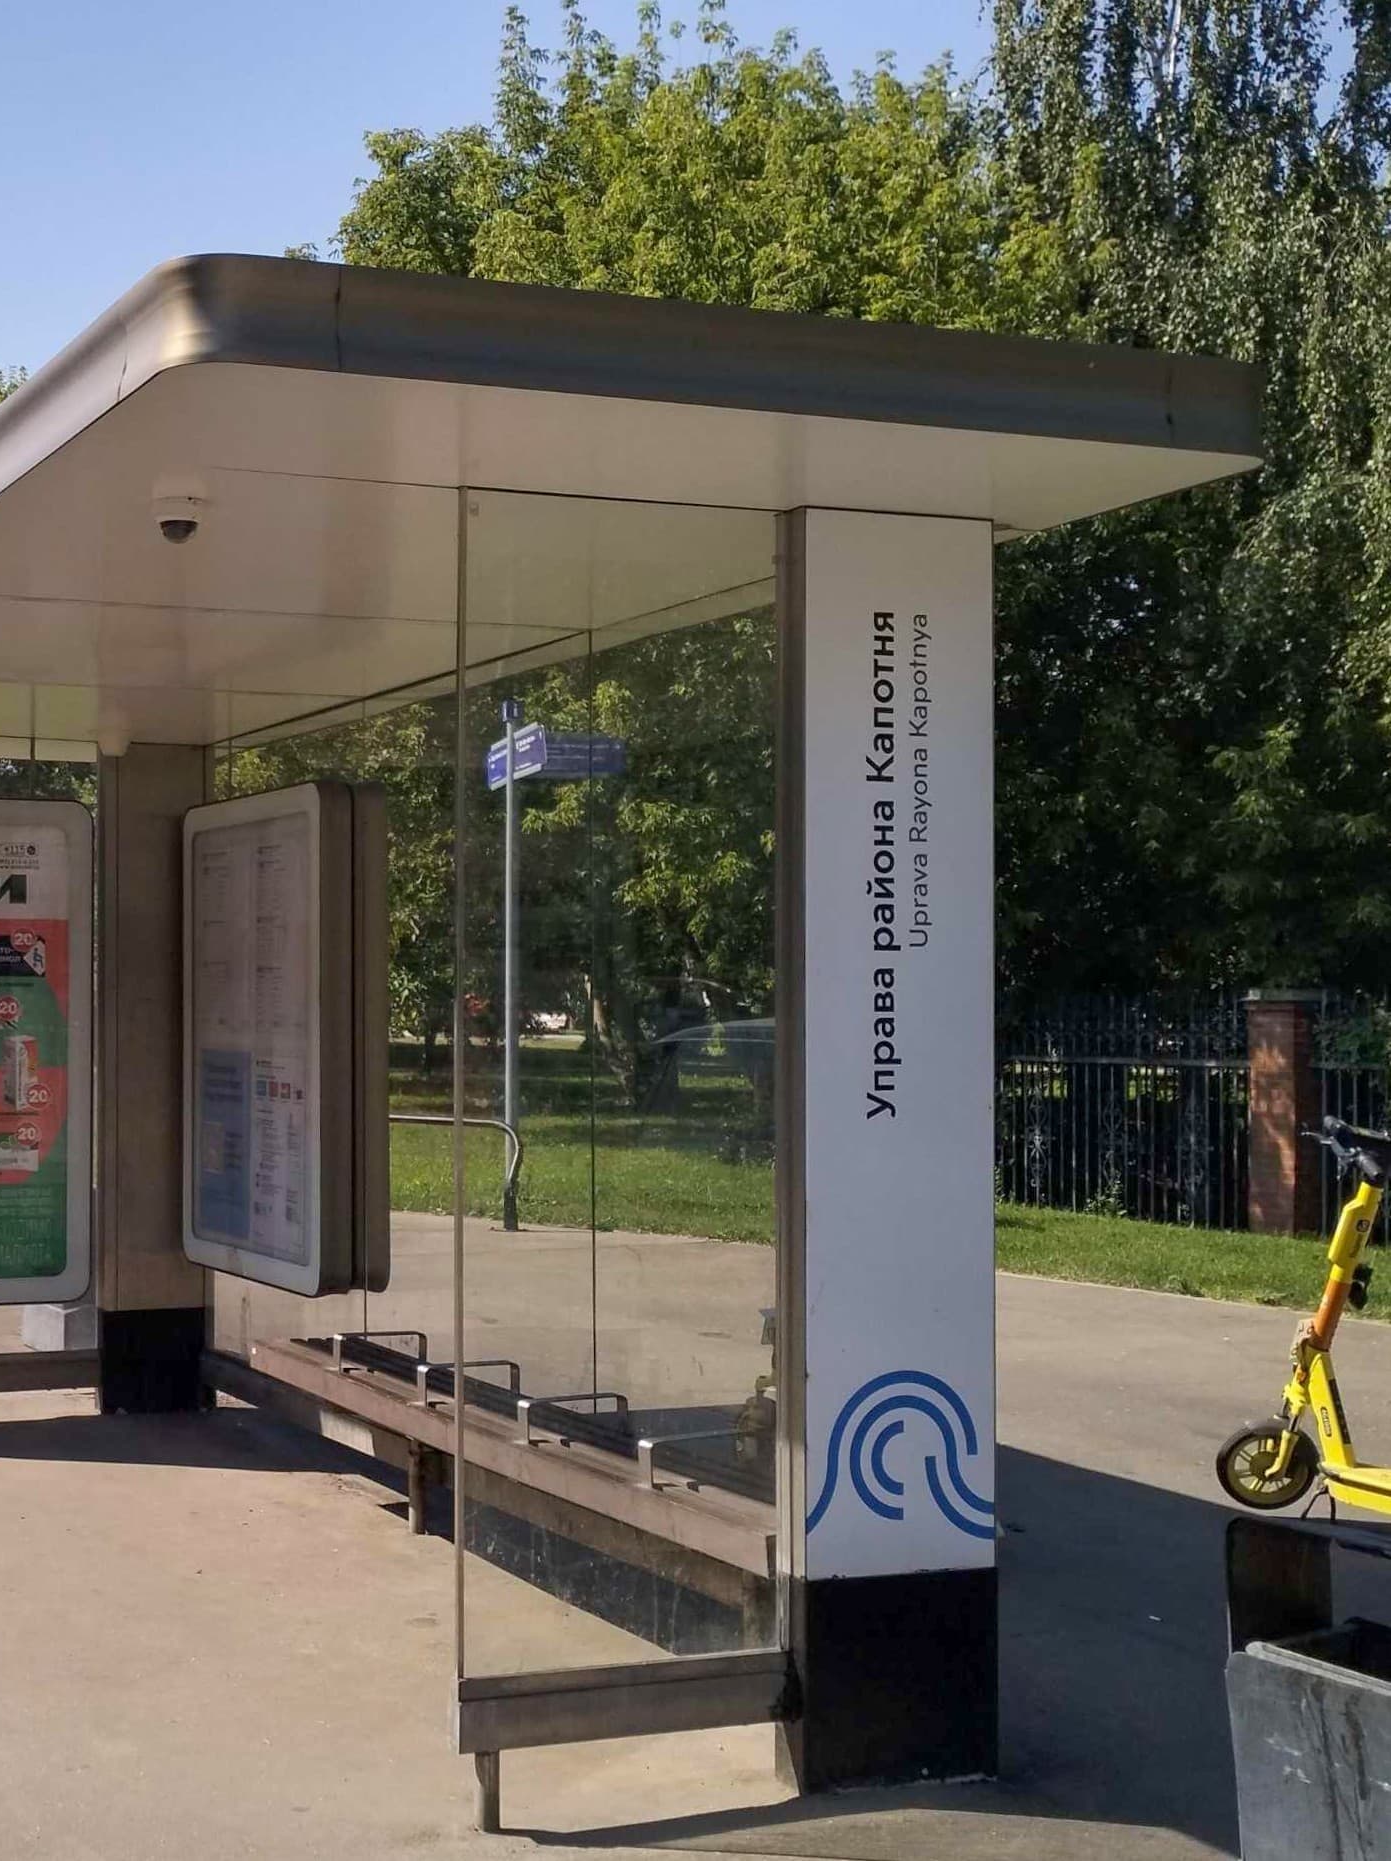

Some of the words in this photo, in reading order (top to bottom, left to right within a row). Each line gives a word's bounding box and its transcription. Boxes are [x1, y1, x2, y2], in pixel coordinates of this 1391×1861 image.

[865, 610, 895, 783] Капотня
[909, 613, 932, 738] Kapotnya
[909, 747, 932, 842] Rayona
[866, 800, 902, 951] района
[909, 853, 932, 948] Uprava
[13, 932, 33, 946] 20
[865, 967, 901, 1119] Управа
[17, 1126, 36, 1140] 20
[28, 1089, 48, 1103] 20
